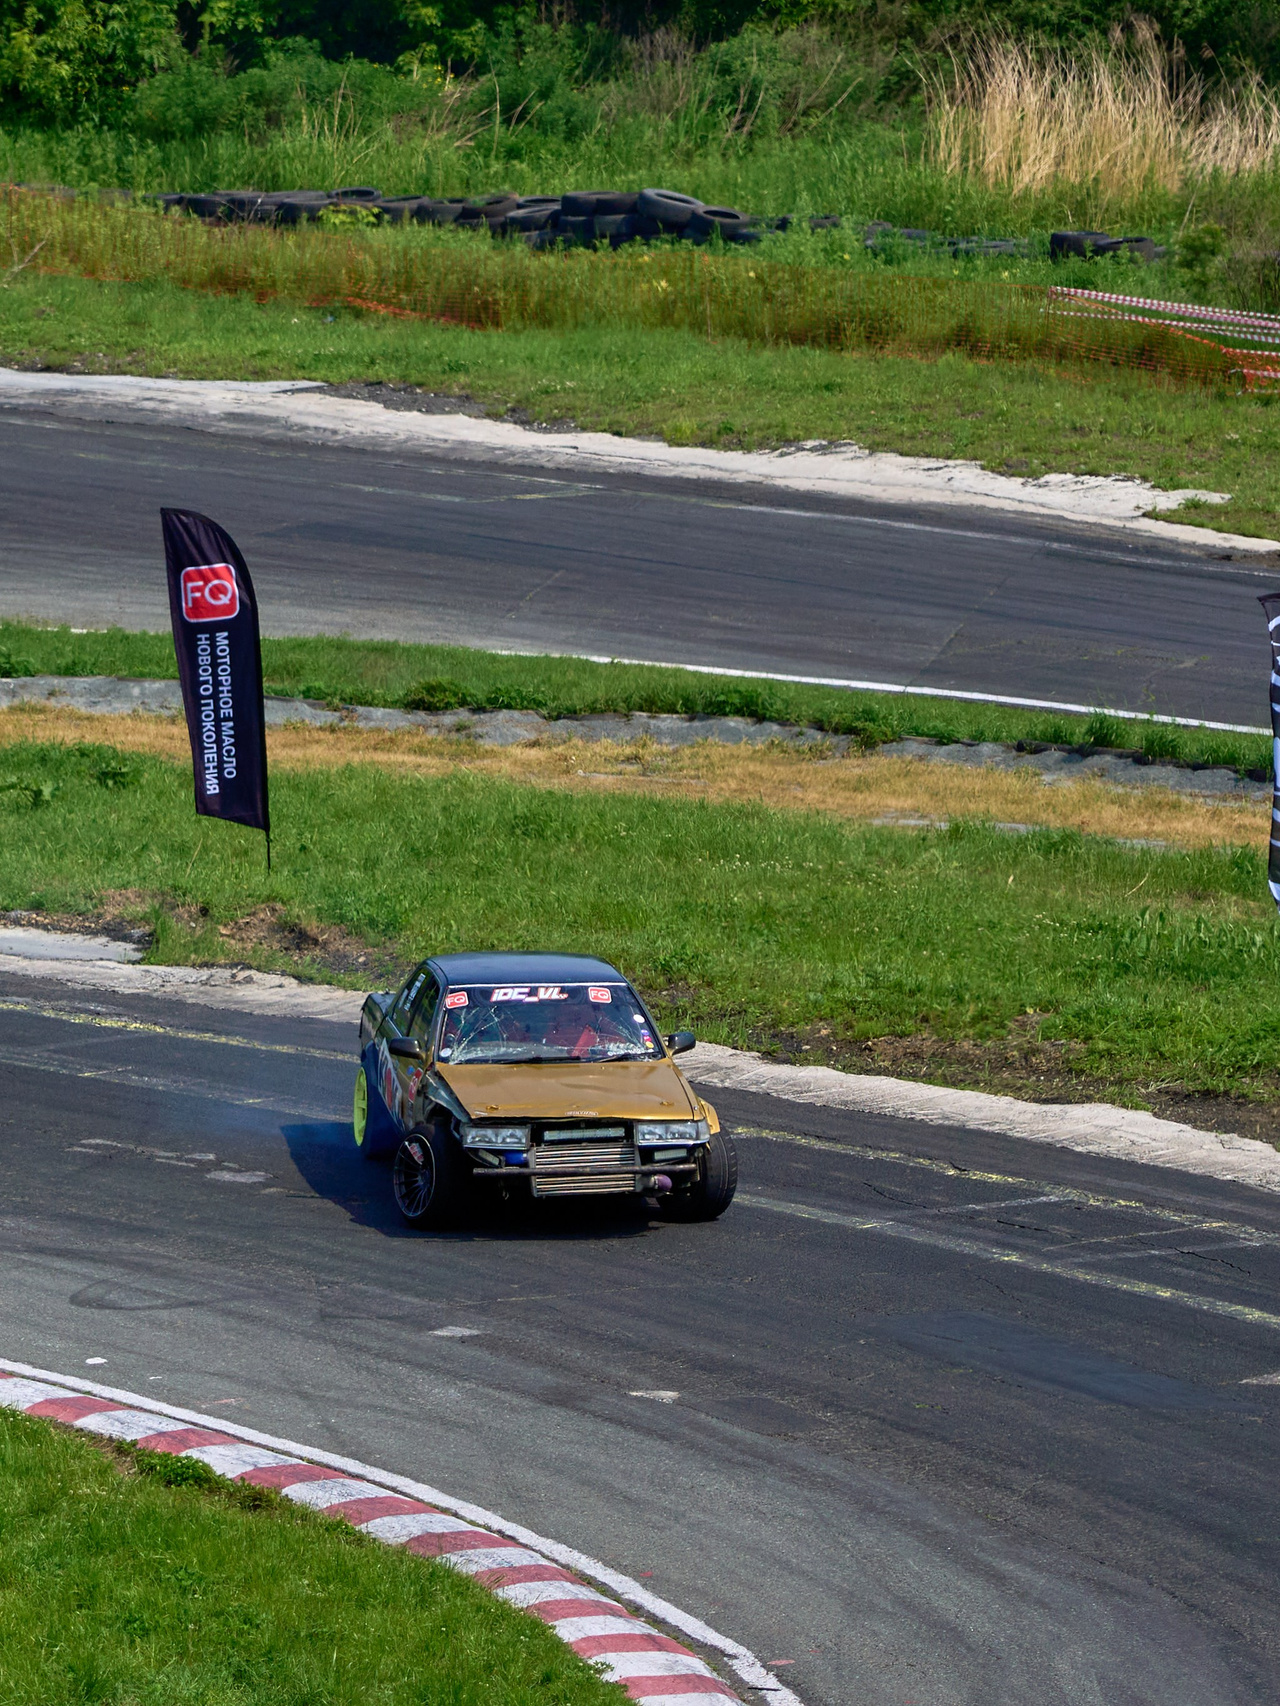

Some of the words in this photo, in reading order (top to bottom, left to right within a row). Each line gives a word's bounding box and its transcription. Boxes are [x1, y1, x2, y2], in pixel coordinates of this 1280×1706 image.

[186, 579, 232, 608] FQ
[196, 634, 213, 696] НОВОГО
[215, 631, 233, 718] МОТОРНОЕ
[201, 699, 220, 795] ПОКОЛЕНИЯ
[221, 721, 237, 779] МАСЛО
[448, 996, 466, 1005] FQ
[591, 991, 609, 999] FQ
